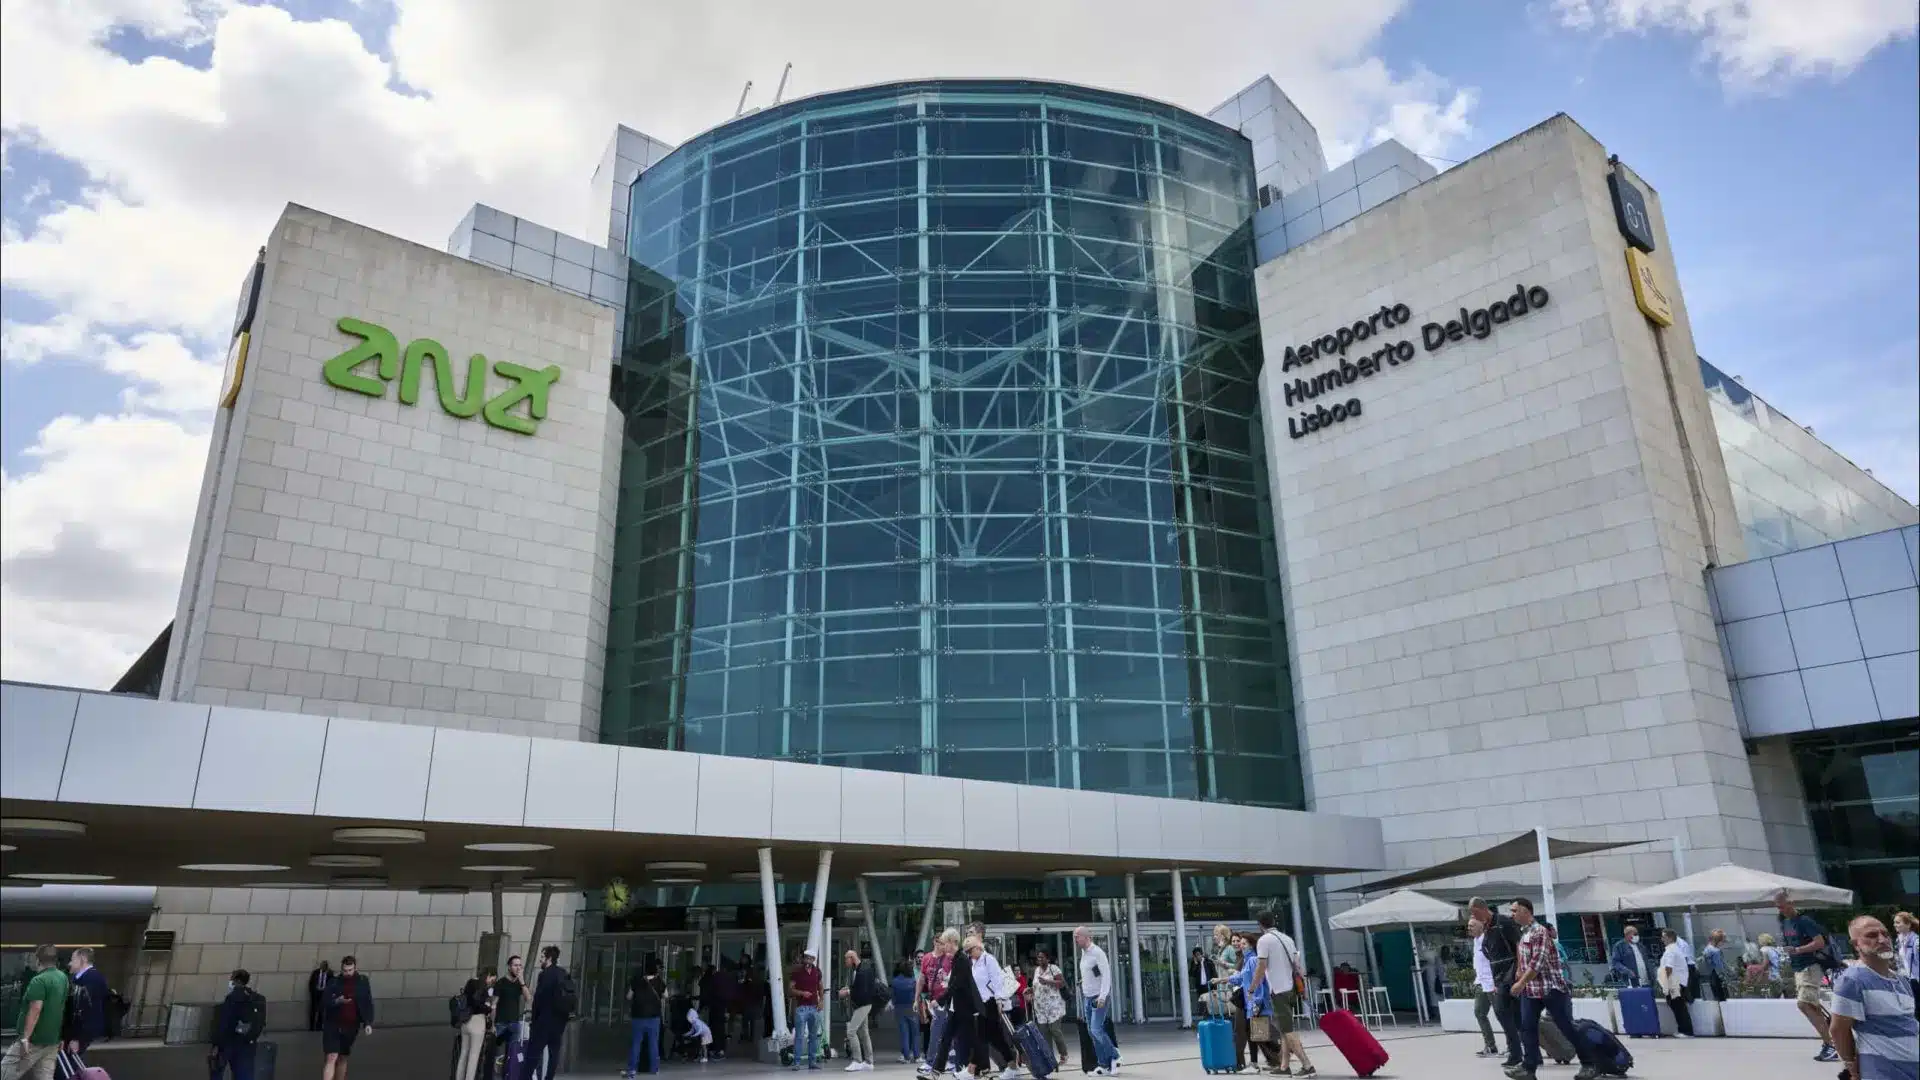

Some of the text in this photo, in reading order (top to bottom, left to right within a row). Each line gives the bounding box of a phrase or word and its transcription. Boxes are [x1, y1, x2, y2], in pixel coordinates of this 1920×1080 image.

[1282, 302, 1412, 373] Aeroporto
[1283, 283, 1551, 408] Humberto Delgado
[1287, 397, 1363, 440] Lisboa
